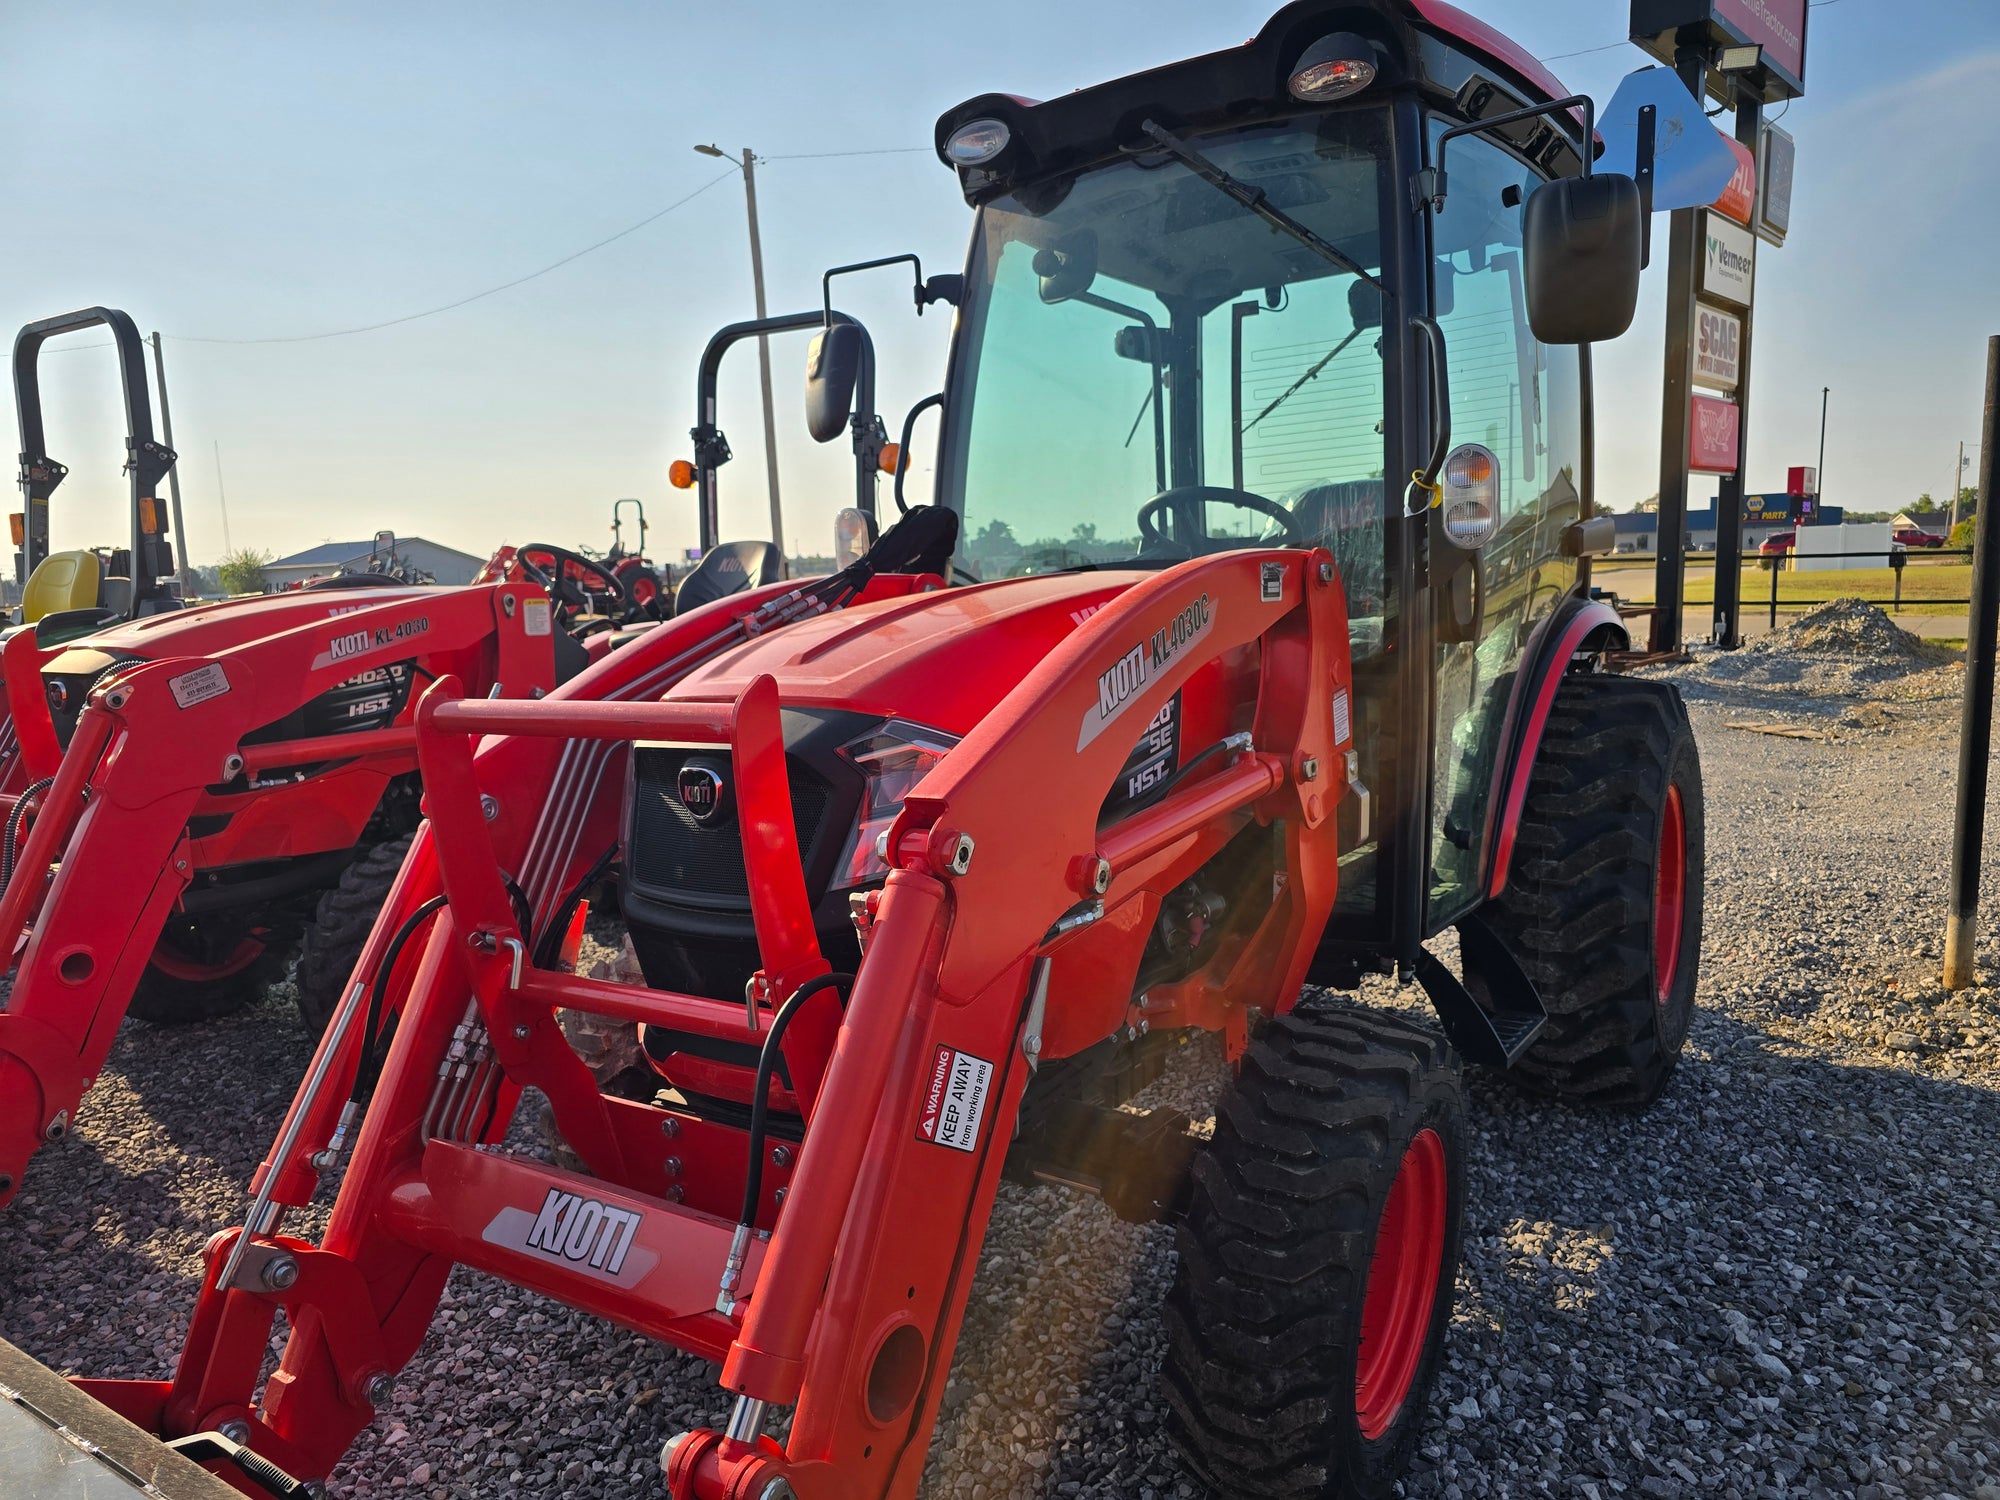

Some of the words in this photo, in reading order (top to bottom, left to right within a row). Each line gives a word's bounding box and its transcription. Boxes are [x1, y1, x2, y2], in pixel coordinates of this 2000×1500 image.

[1719, 241, 1751, 275] Vermeer
[1699, 312, 1736, 361] SCAG
[1762, 511, 1787, 520] PARTS
[330, 630, 370, 660] KIOTI
[1098, 641, 1146, 720] KIOTI
[1151, 593, 1209, 673] KL4030C
[684, 785, 711, 803] KIOTI
[1129, 760, 1165, 799] HST
[926, 1051, 950, 1114] WARNING
[941, 1104, 960, 1143] KEEP
[952, 1058, 972, 1102] AWAY
[959, 1124, 973, 1146] from
[967, 1085, 983, 1122] working
[976, 1064, 987, 1084] area
[526, 1187, 643, 1276] KIOTI
